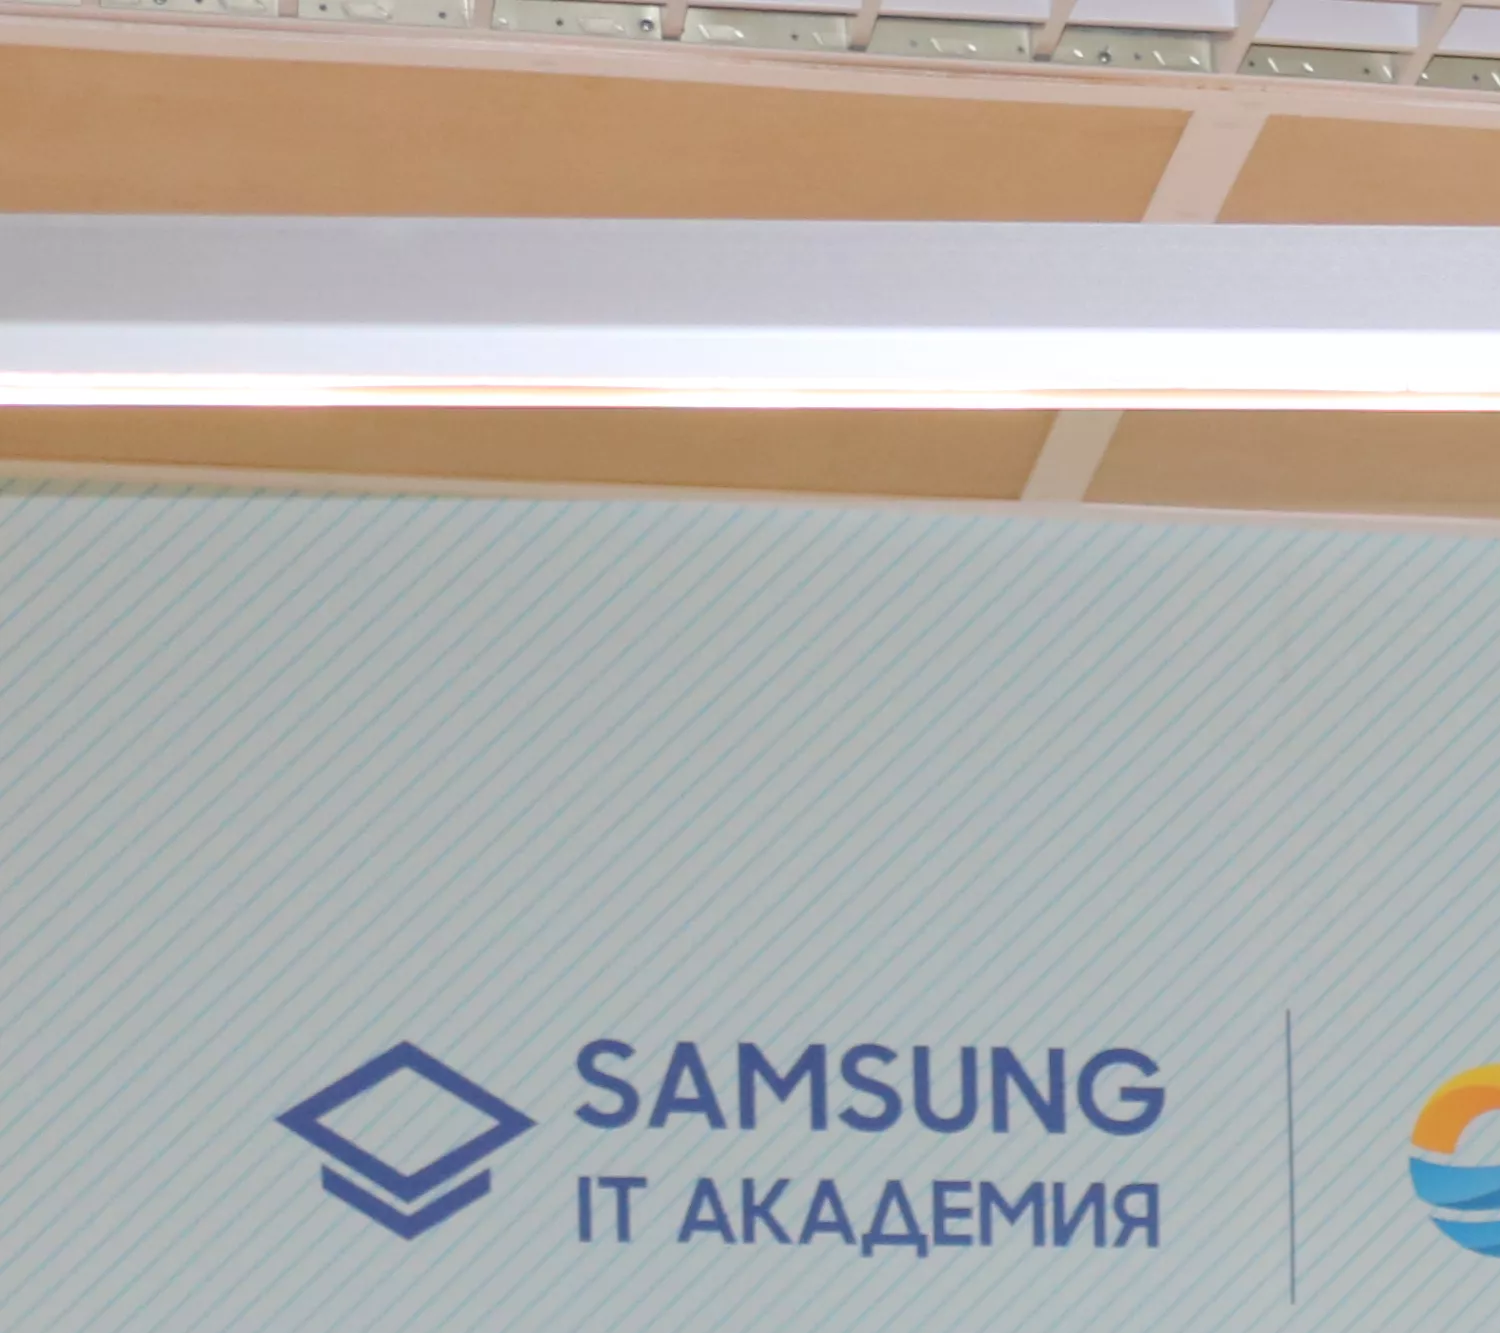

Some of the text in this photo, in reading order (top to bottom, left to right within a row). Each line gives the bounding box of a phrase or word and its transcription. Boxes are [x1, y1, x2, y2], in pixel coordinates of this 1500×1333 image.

[573, 1037, 1166, 1137] SAMSUNG
[576, 1174, 1160, 1259] IT АКАДЕМИЯ
